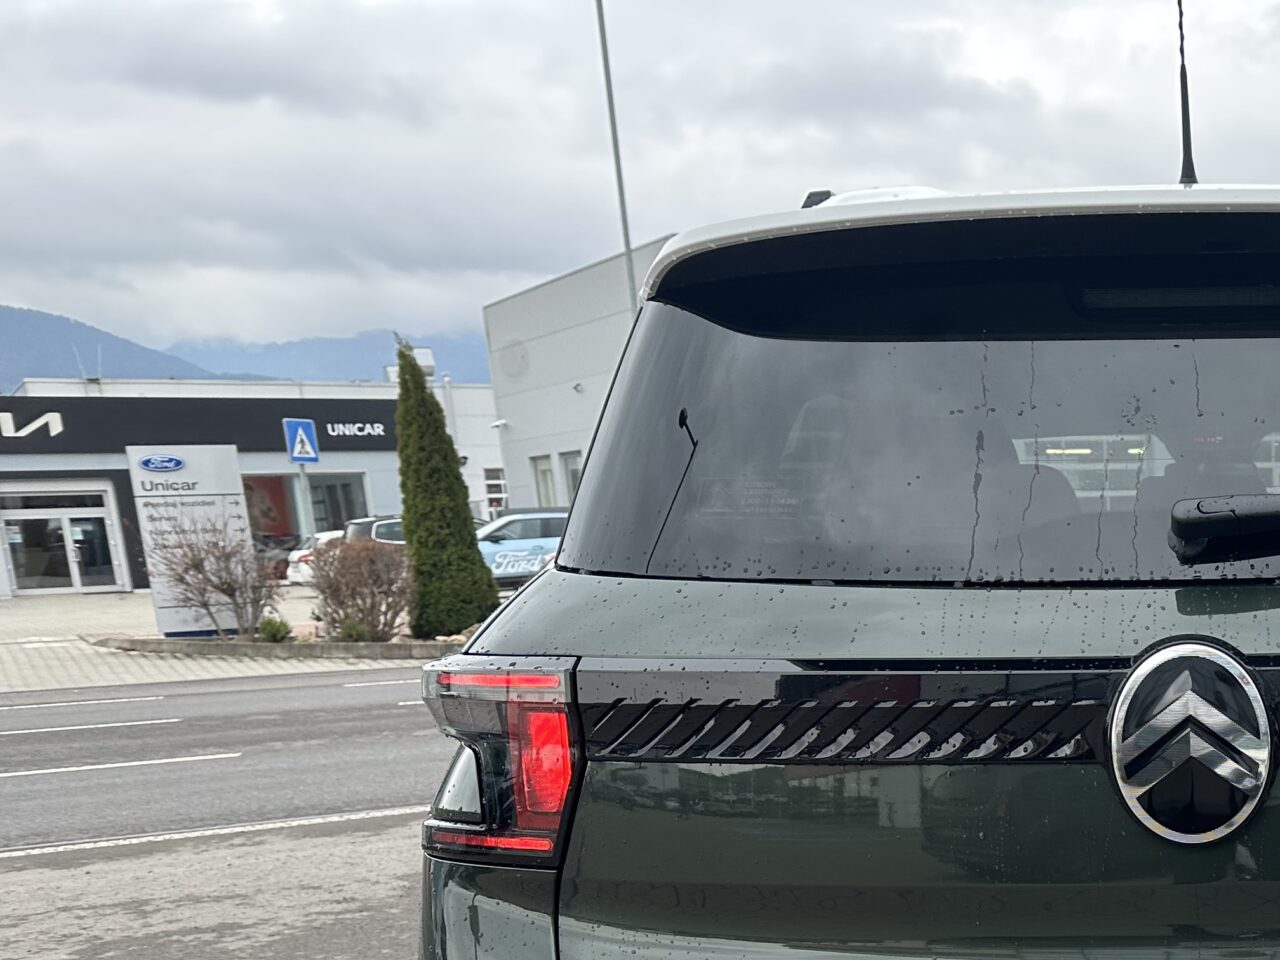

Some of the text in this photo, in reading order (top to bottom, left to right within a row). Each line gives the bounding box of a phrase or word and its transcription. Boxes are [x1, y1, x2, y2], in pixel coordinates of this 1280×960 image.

[326, 422, 386, 436] UNICAR
[140, 479, 199, 492] Unicar
[490, 550, 545, 573] Ford
